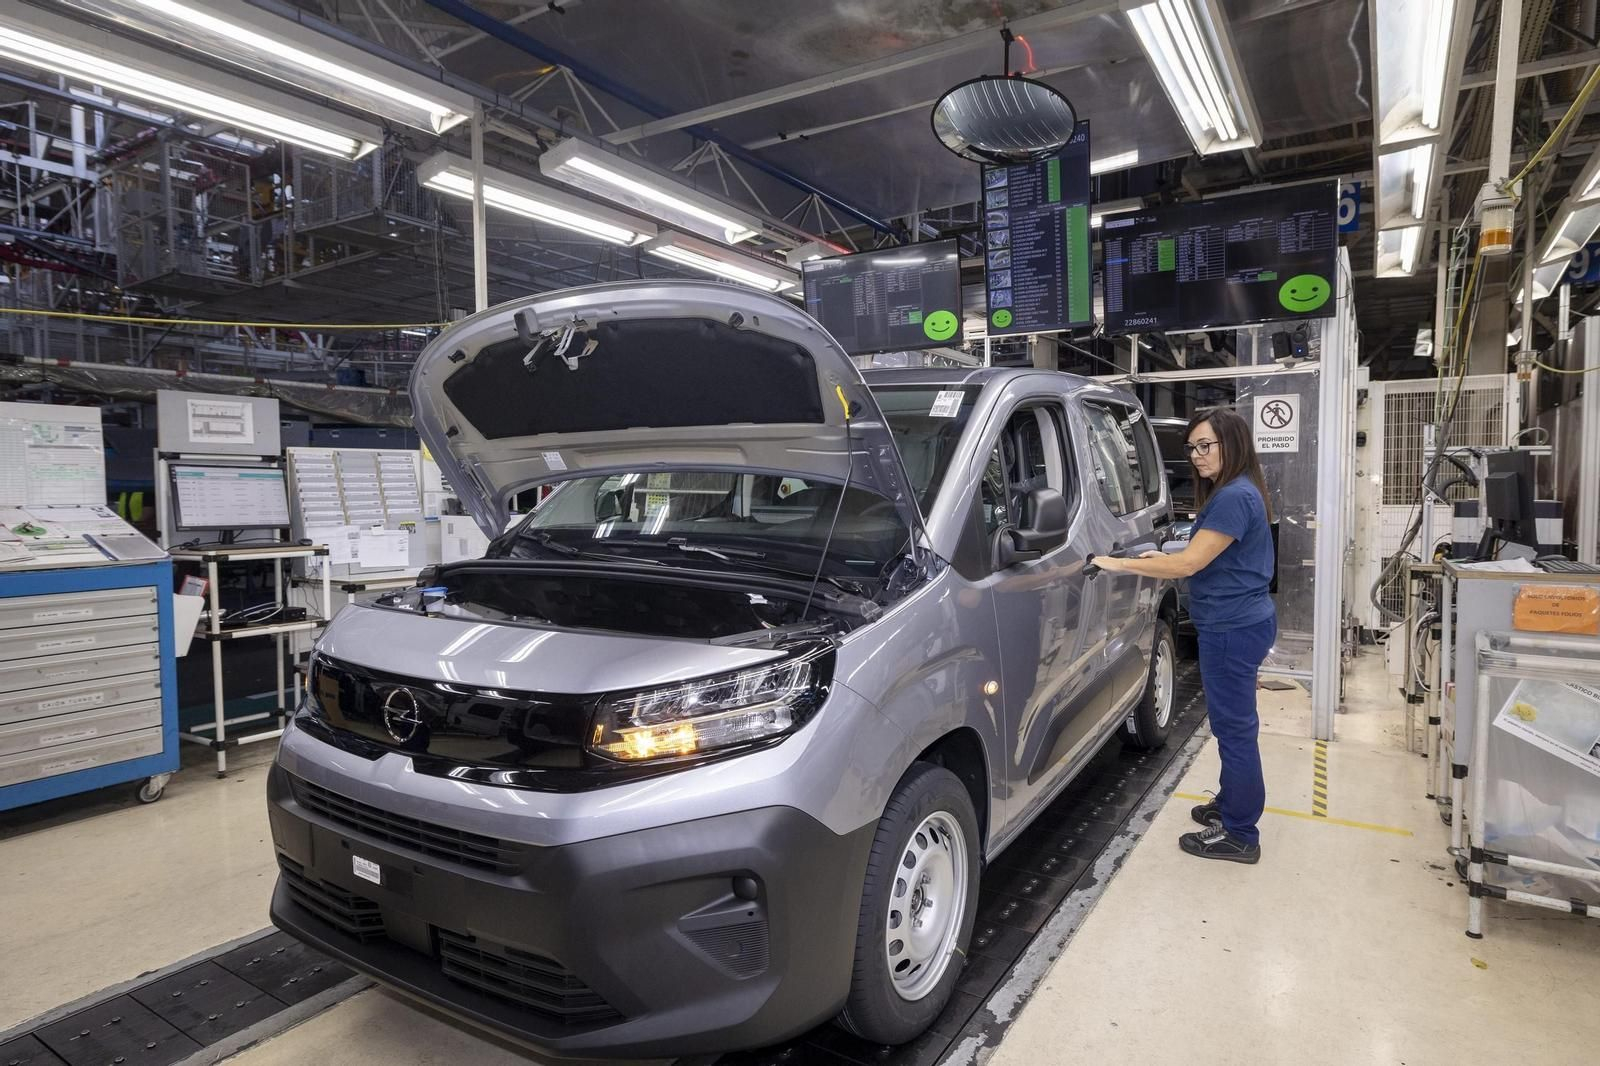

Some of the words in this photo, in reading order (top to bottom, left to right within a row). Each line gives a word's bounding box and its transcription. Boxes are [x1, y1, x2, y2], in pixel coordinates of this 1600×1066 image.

[1568, 247, 1600, 280] 9
[1124, 317, 1157, 327] 22860241
[1529, 609, 1560, 617] PAQUETES
[1566, 683, 1593, 696] ASTICO
